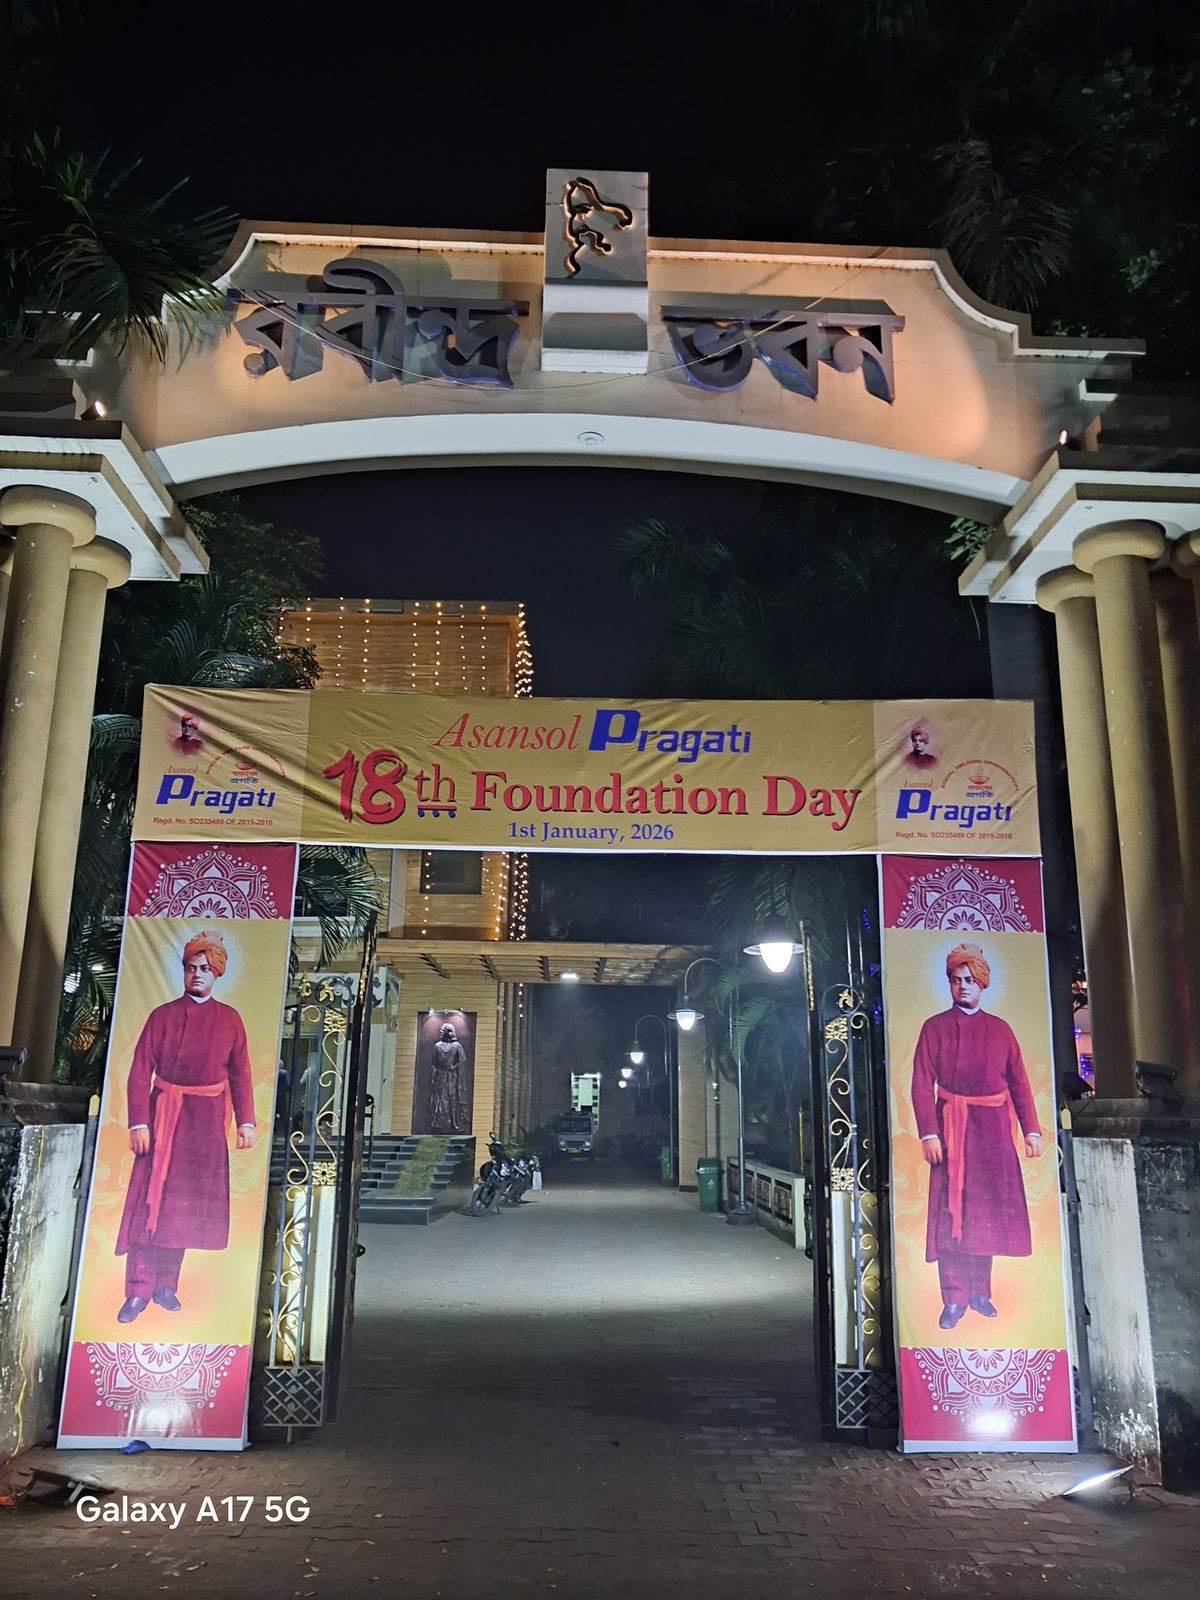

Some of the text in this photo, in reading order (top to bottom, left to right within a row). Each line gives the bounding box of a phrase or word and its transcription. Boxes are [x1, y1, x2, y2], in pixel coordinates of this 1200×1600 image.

[227, 258, 906, 404] রবীন্দ্র ভবন
[435, 709, 752, 764] Asansol Pragati
[164, 765, 199, 774] Asansol
[156, 774, 276, 814] Pragati
[323, 748, 861, 832] 18th Foundation Day
[896, 789, 1012, 829] Pragati
[153, 817, 173, 825] Regd.
[175, 817, 186, 825] No.
[508, 821, 674, 844] 1st January, 2026
[895, 831, 914, 839] Regd.
